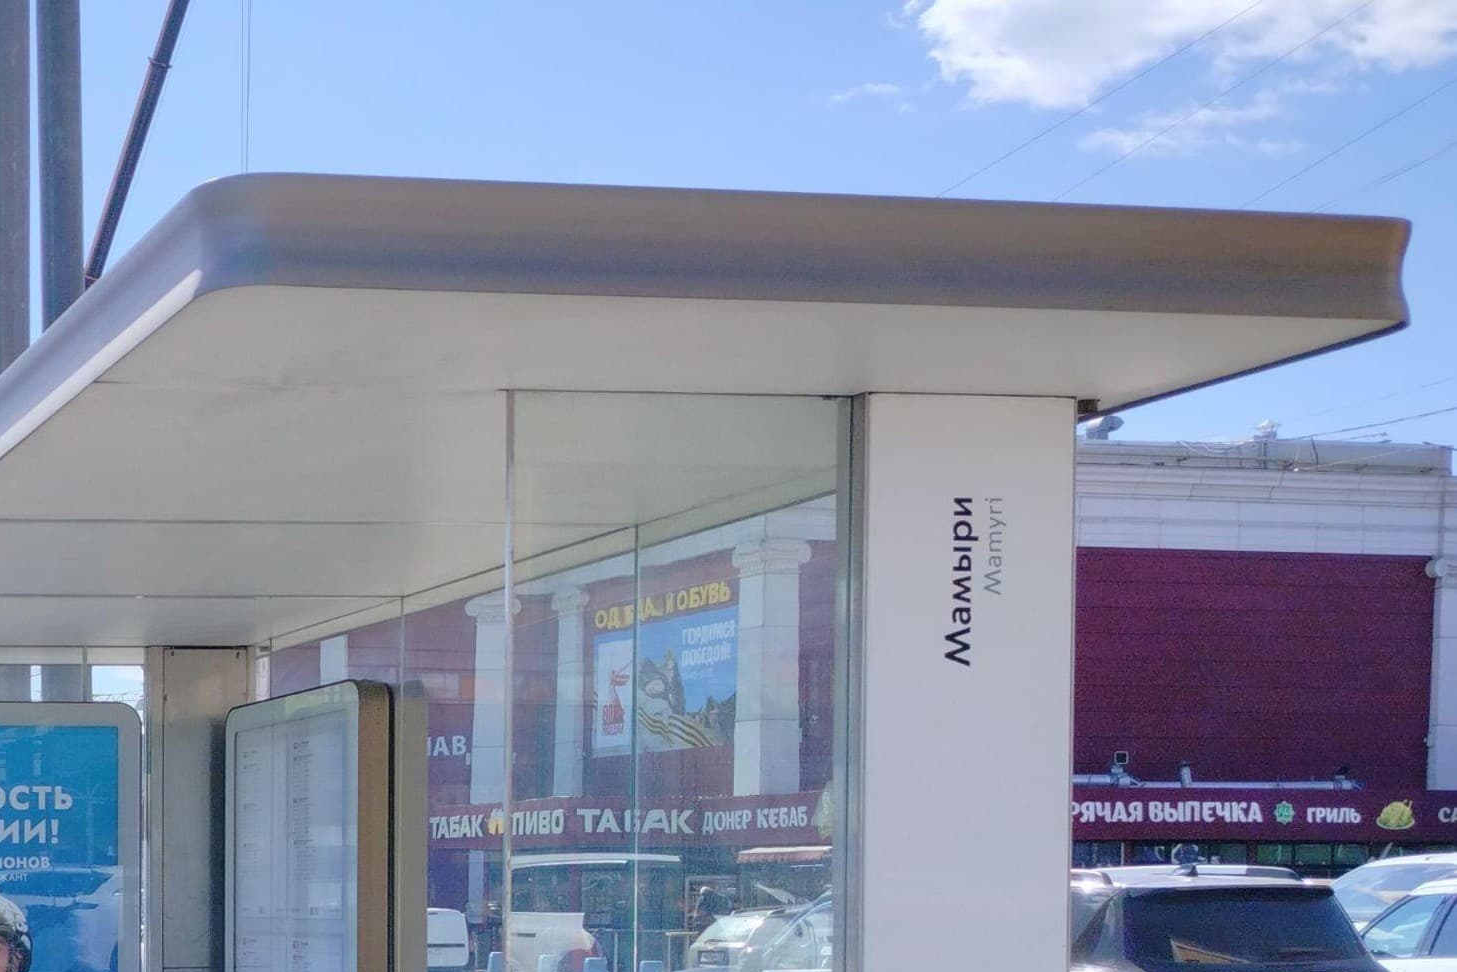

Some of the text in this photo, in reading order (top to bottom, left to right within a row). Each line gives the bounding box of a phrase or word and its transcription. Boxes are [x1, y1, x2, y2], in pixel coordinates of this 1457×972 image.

[983, 498, 1007, 596] Mamyri
[677, 581, 731, 610] ОБУВЬ
[944, 497, 979, 667] Мамыри
[429, 809, 564, 839] ТАБАК ПИВО
[702, 806, 808, 835] ДОНЕР КЕБАБ
[1148, 801, 1263, 823] ВЫПЕЧКА
[1307, 807, 1361, 823] ГРИЛЬ
